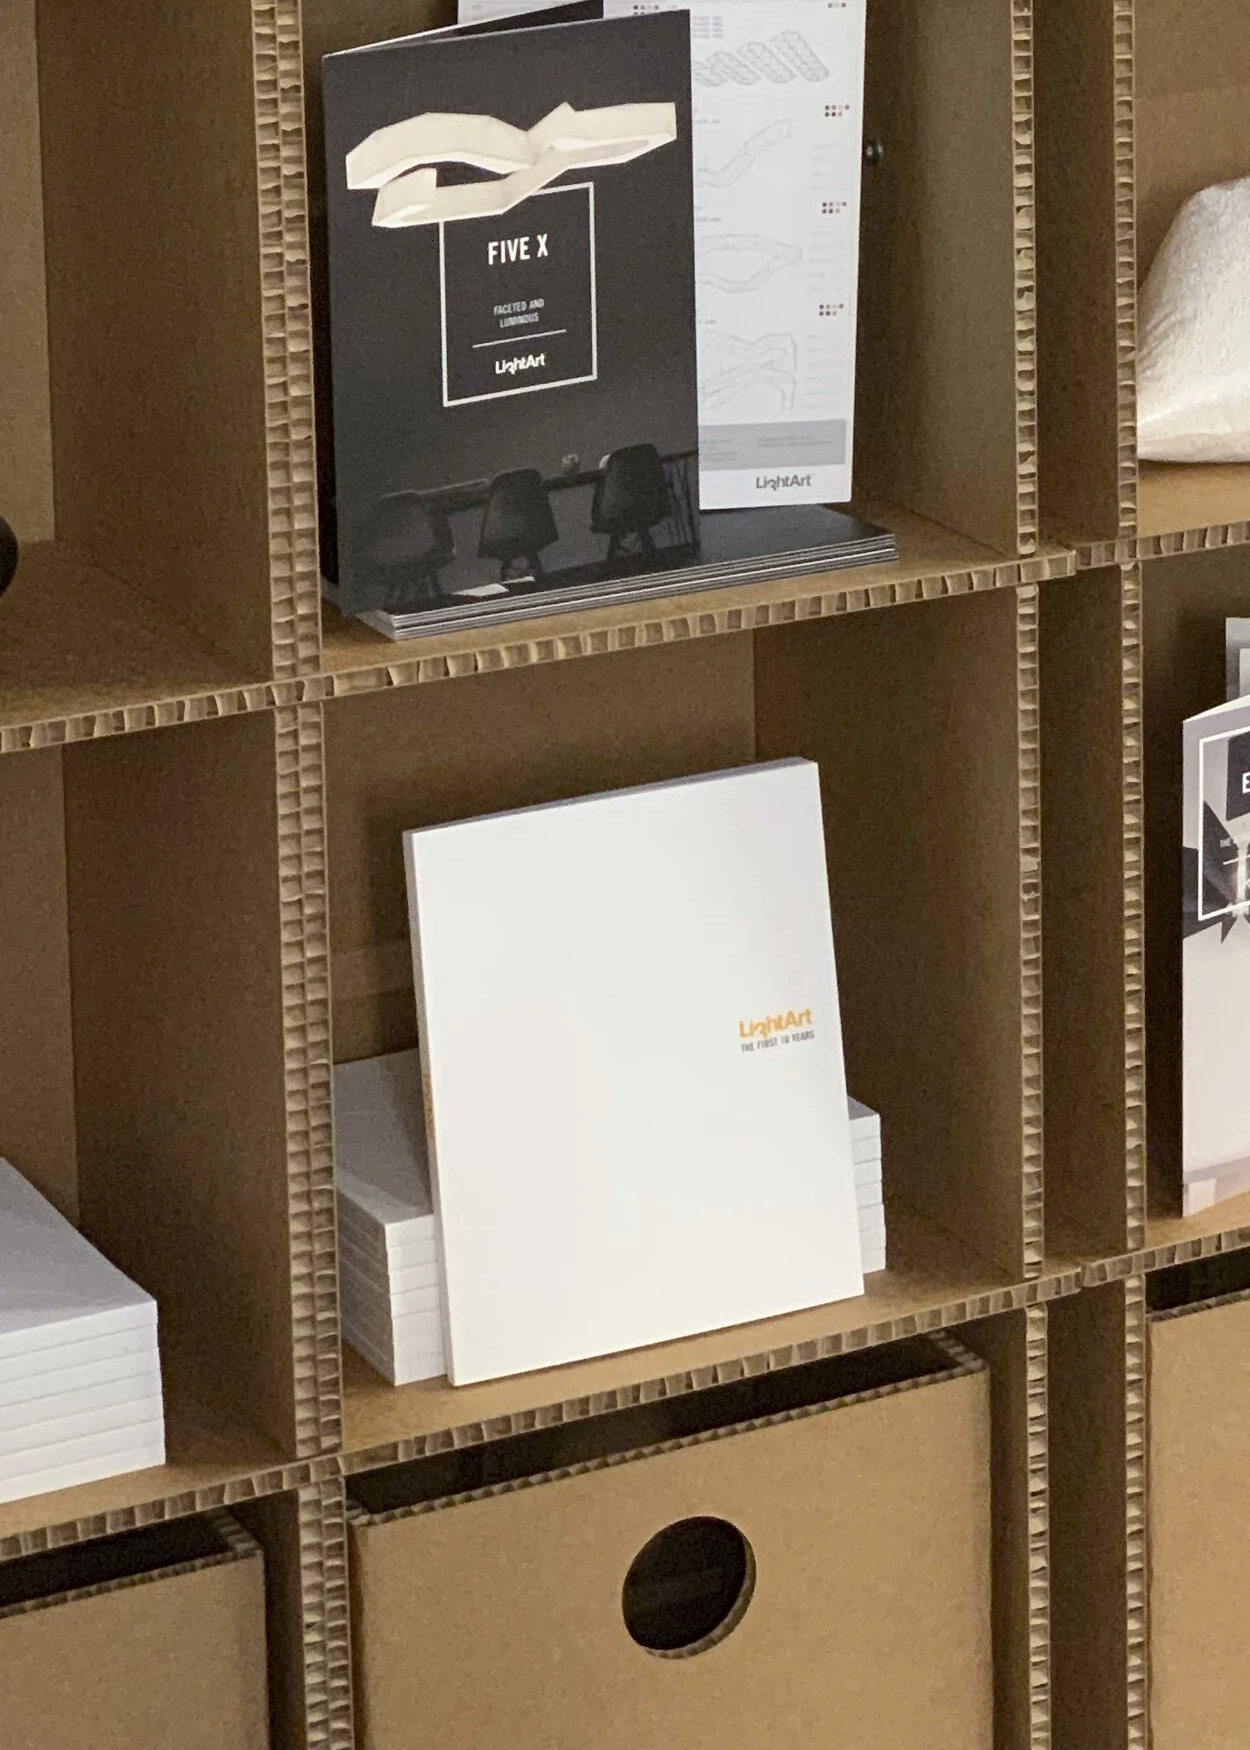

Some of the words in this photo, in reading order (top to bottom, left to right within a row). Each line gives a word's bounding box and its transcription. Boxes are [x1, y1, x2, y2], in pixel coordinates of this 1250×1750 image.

[488, 236, 531, 266] FIVE
[536, 233, 549, 258] X
[493, 301, 528, 316] FACETED
[529, 298, 545, 310] AND
[495, 353, 546, 375] LightArt
[756, 474, 812, 491] LightArt
[739, 1007, 813, 1039] LightArt
[756, 1037, 778, 1050] FIRST
[792, 1030, 815, 1043] YEARS
